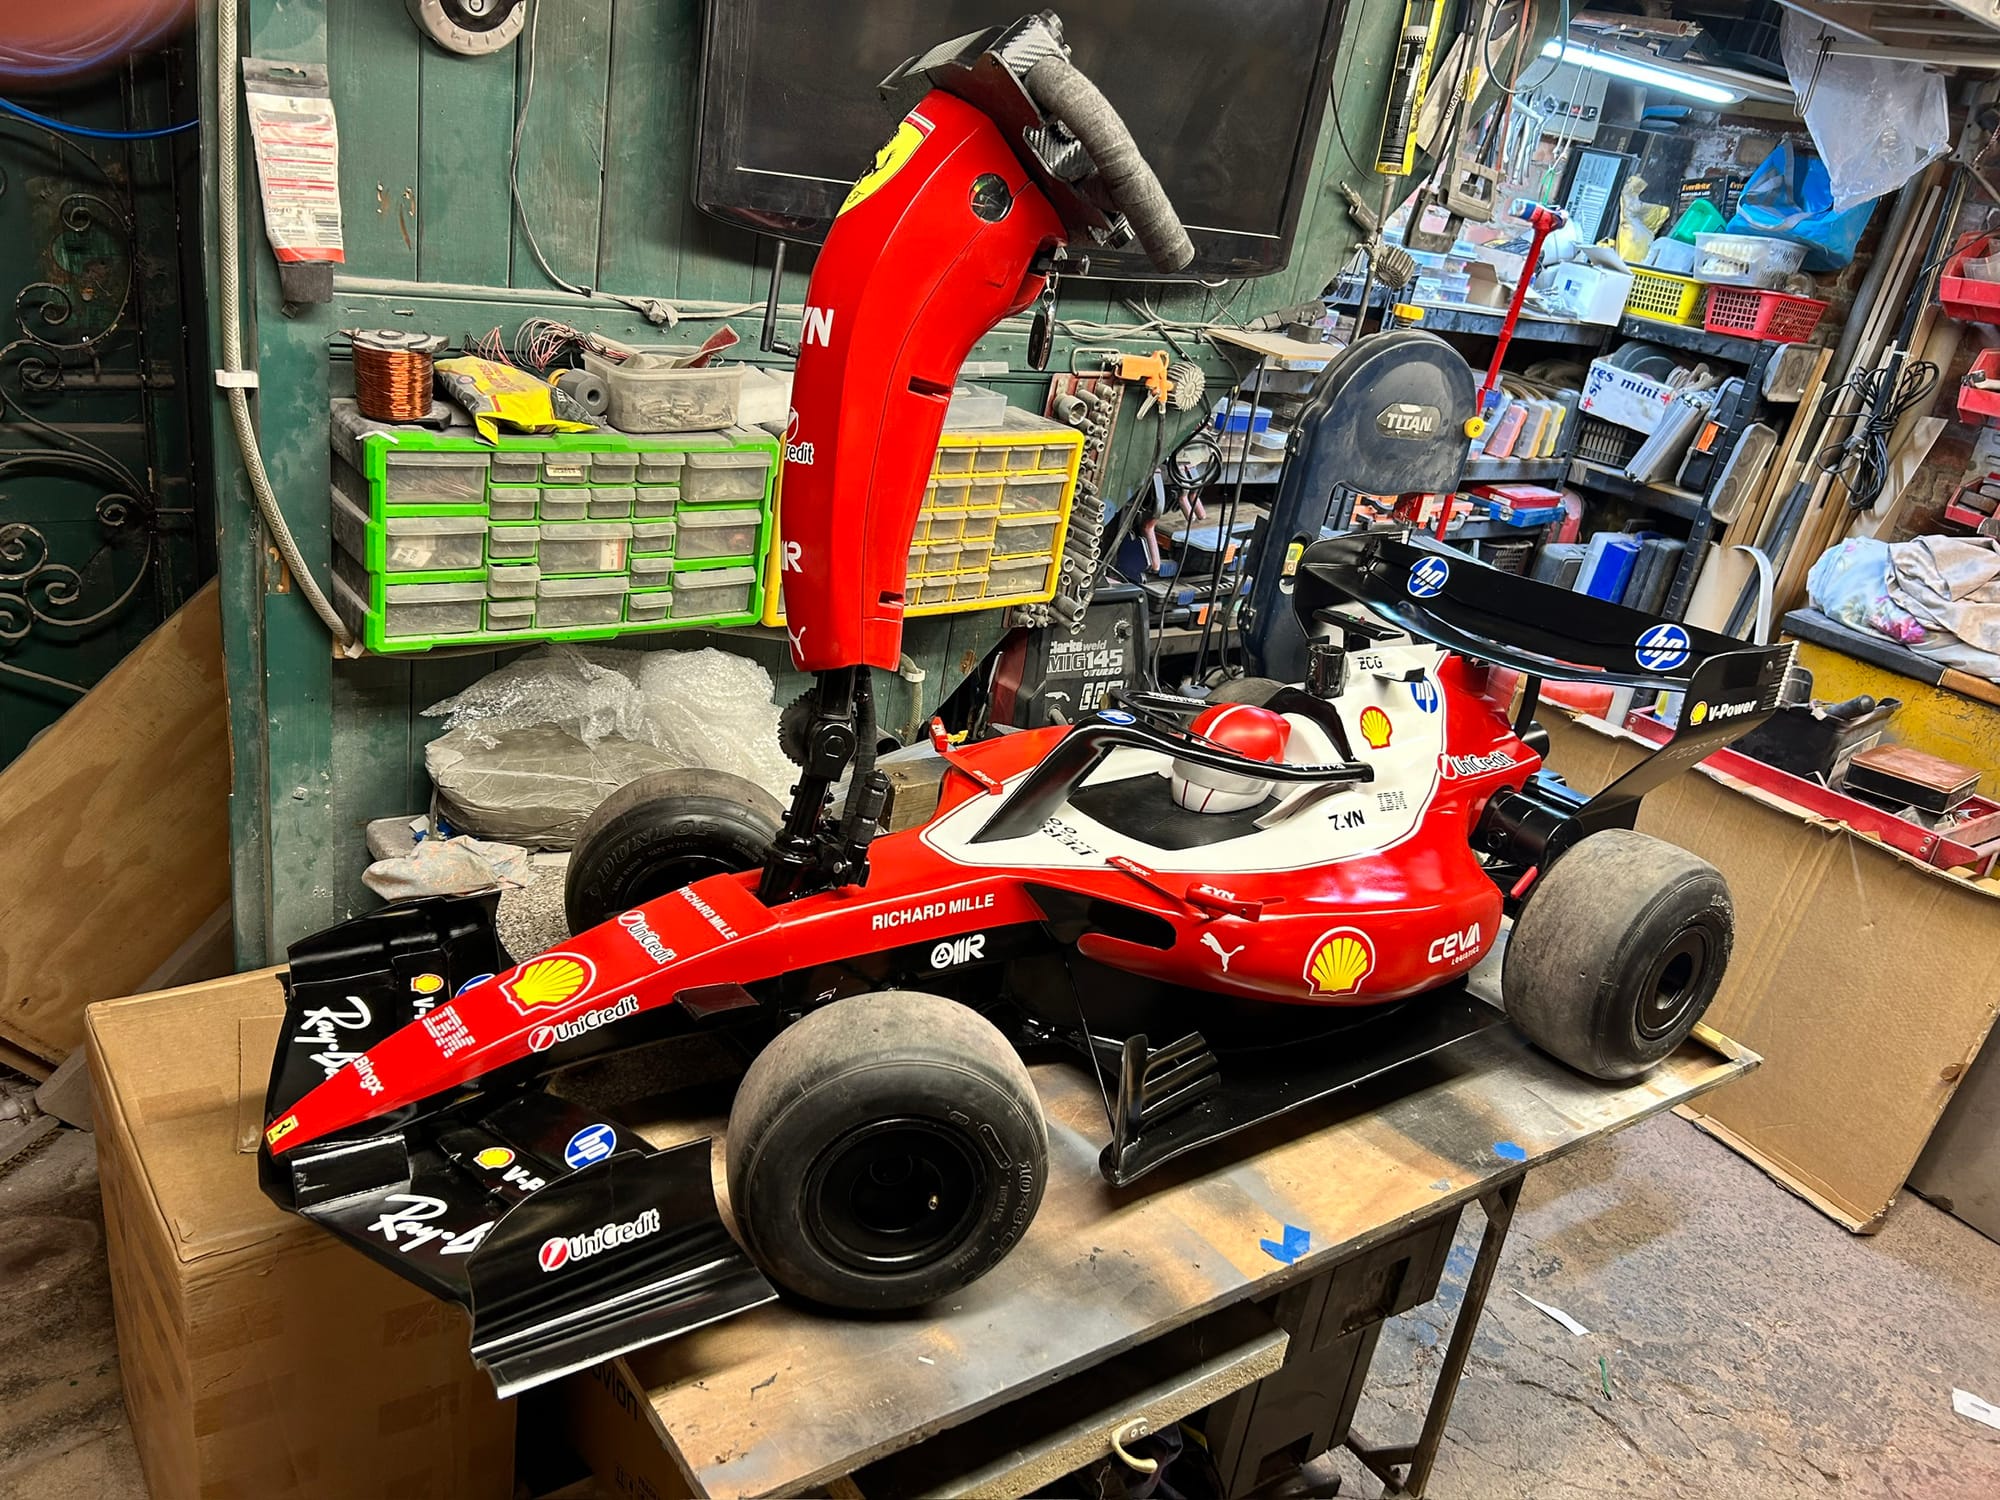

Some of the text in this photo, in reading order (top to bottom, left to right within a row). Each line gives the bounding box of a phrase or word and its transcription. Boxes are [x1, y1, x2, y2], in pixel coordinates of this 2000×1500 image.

[801, 306, 835, 348] YN
[1591, 366, 1659, 400] res mini
[1386, 412, 1433, 432] TITAN
[785, 442, 815, 466] redit
[1642, 624, 1688, 670] hp
[1708, 700, 1758, 722] V-Power
[1452, 751, 1516, 776] UniCredit
[1376, 790, 1408, 812] IBM
[677, 885, 739, 941] RICHARD MILLE
[871, 893, 995, 931] RICHARD MILLE
[627, 921, 677, 964] UniCredit
[412, 996, 436, 1020] V-
[555, 996, 639, 1041] UniCredit
[421, 1004, 477, 1059] IBM
[502, 1165, 546, 1192] V-P
[367, 1193, 496, 1256] Ray-B
[568, 1208, 661, 1262] UniCredit
[591, 1360, 639, 1422] vion
